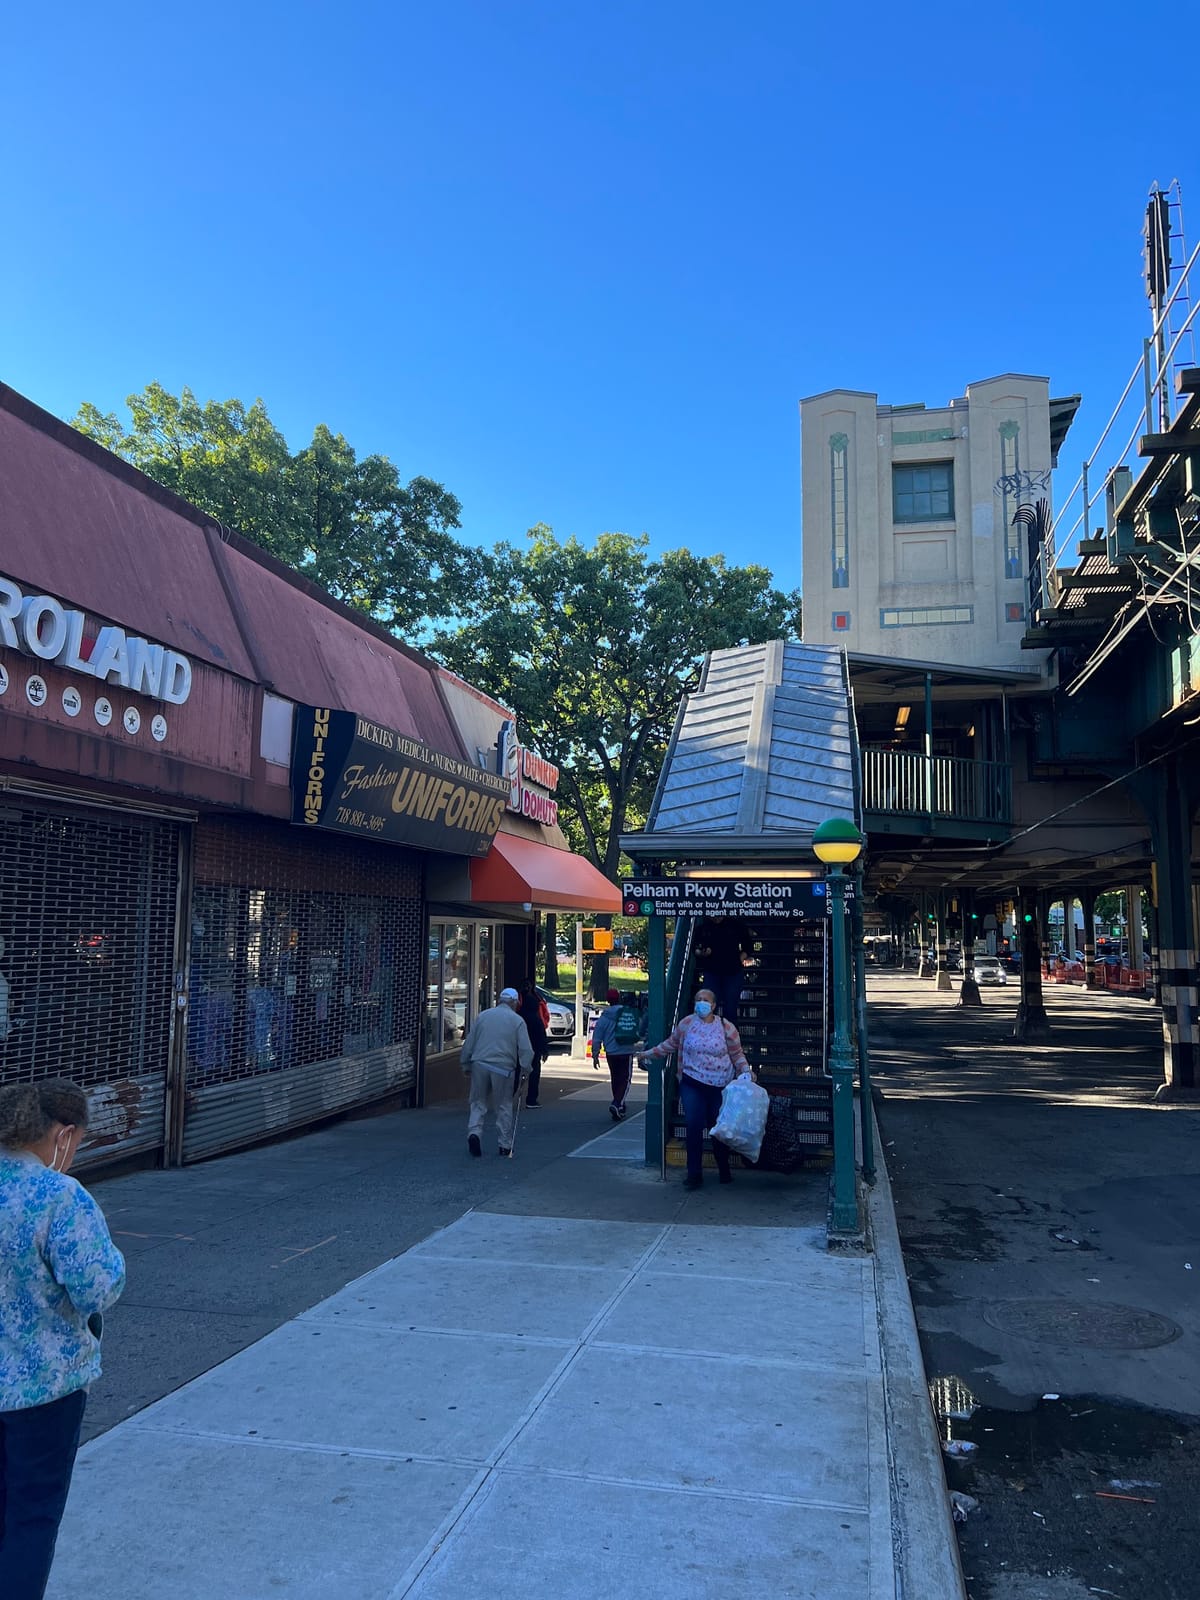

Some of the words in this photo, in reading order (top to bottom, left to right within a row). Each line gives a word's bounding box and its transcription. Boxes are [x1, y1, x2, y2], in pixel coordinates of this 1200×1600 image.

[357, 719, 394, 748] DICKIES
[397, 736, 430, 763] MEDICAL
[434, 753, 457, 775] NURSE
[463, 765, 479, 783] MATE
[482, 773, 510, 794] CHEROKEE
[304, 708, 330, 824] UNIFORMS
[341, 763, 398, 799] Fashion
[391, 767, 506, 836] UNIFORMS
[522, 788, 558, 826] DONUTS
[336, 807, 351, 824] 718
[623, 883, 679, 897] Pelham
[685, 883, 728, 900] Pkwy
[734, 883, 792, 897] Station
[628, 903, 635, 912] 2
[644, 903, 651, 912] 5
[705, 901, 719, 909] buy
[705, 909, 726, 917] agent
[769, 909, 790, 918] Pkwy
